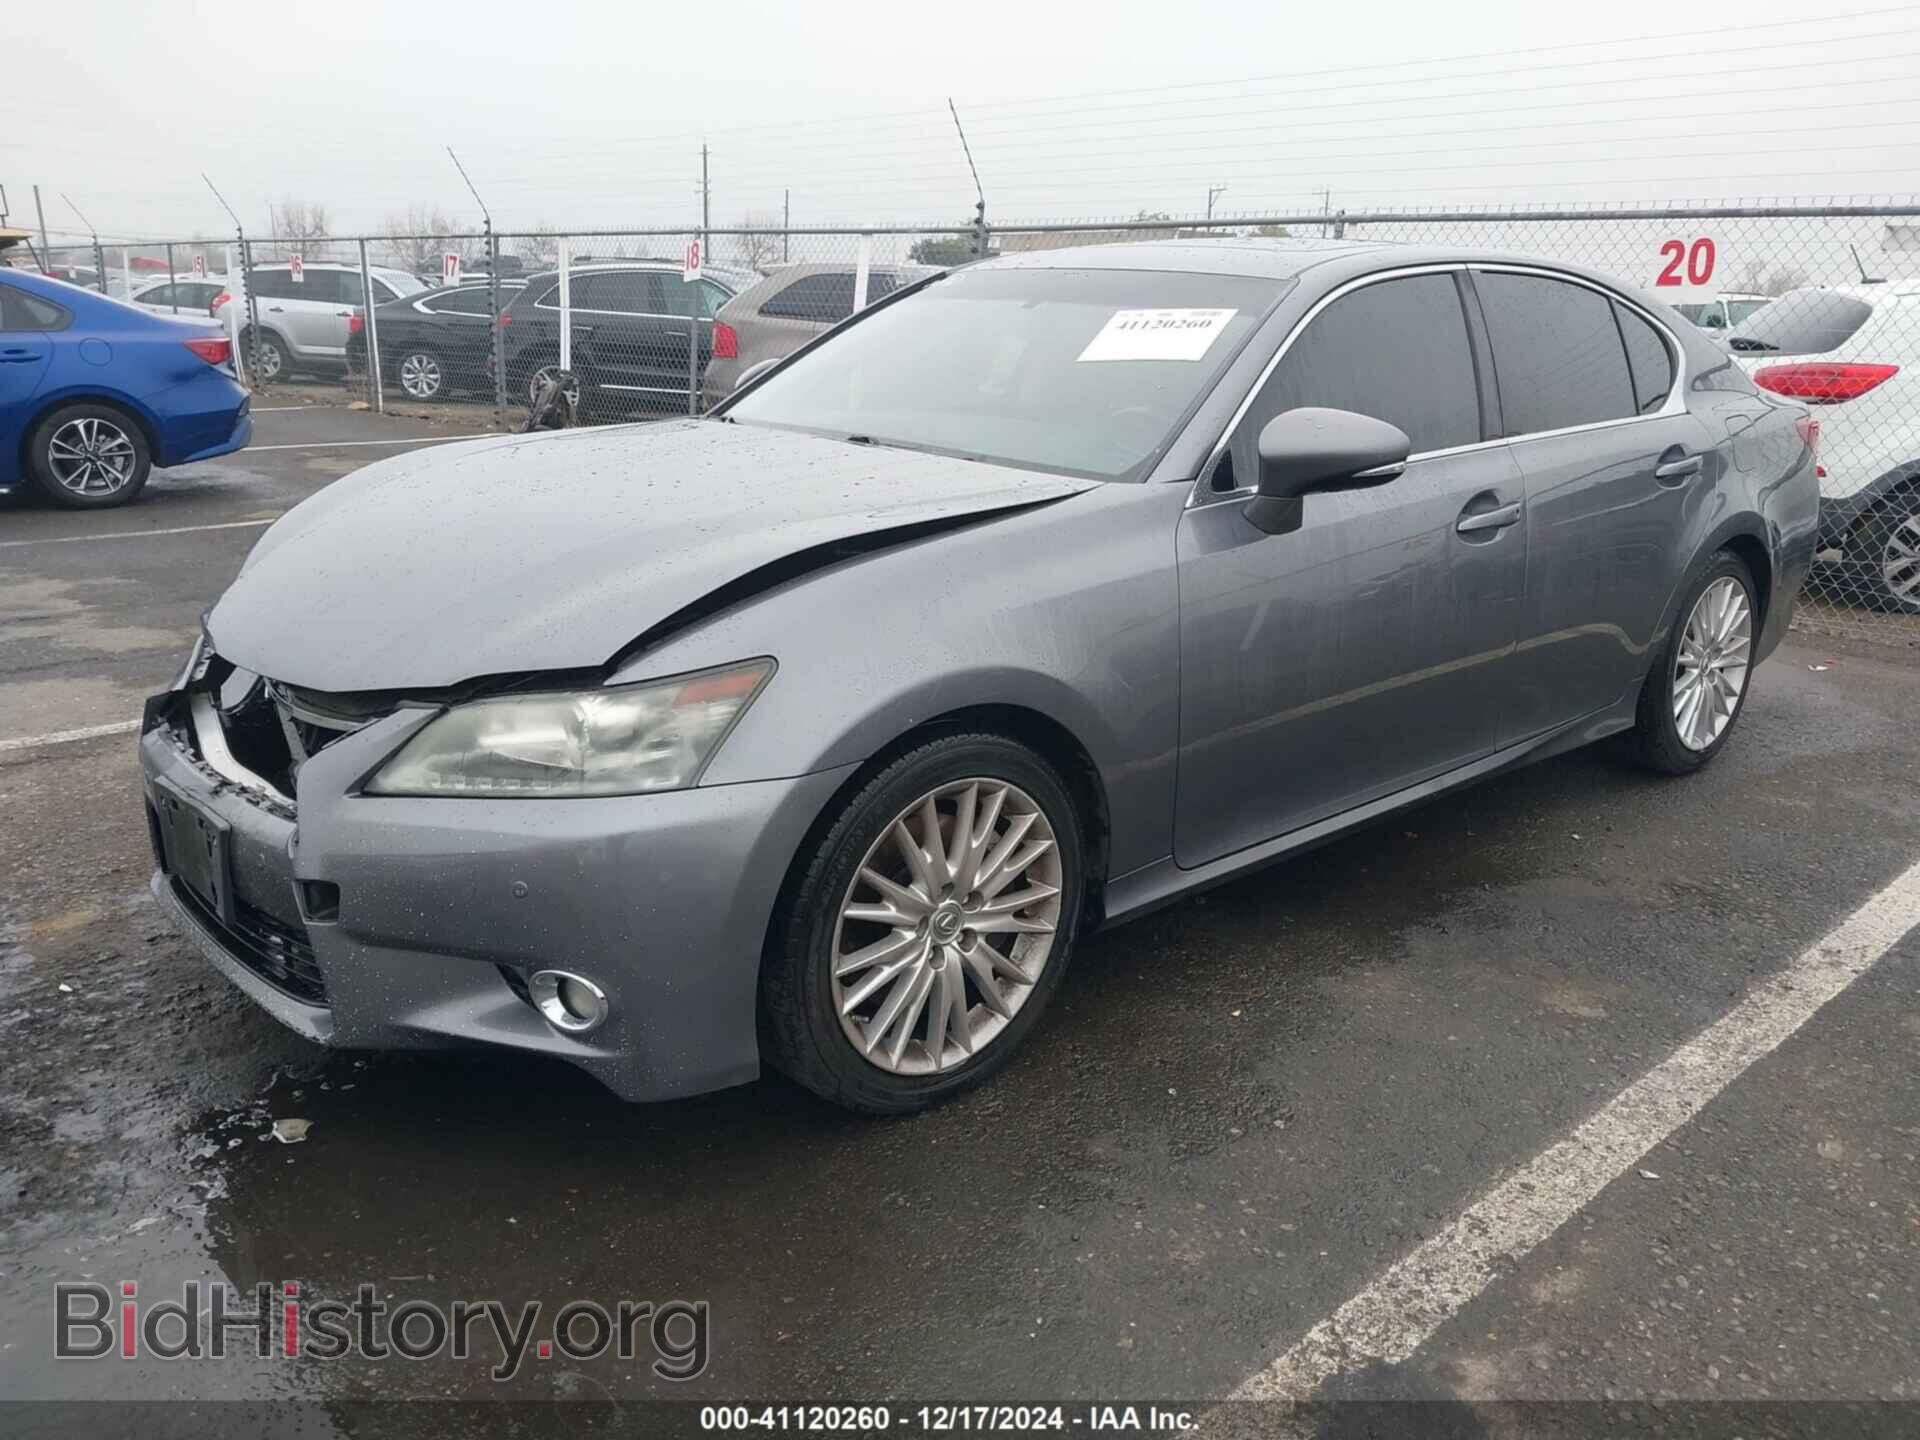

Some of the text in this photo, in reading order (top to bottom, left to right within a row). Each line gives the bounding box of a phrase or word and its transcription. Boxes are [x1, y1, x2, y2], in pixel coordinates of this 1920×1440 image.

[291, 255, 302, 274] 16
[445, 255, 458, 276] 17
[686, 242, 699, 270] 18
[1655, 238, 1715, 287] 20
[1117, 318, 1213, 330] 41120260
